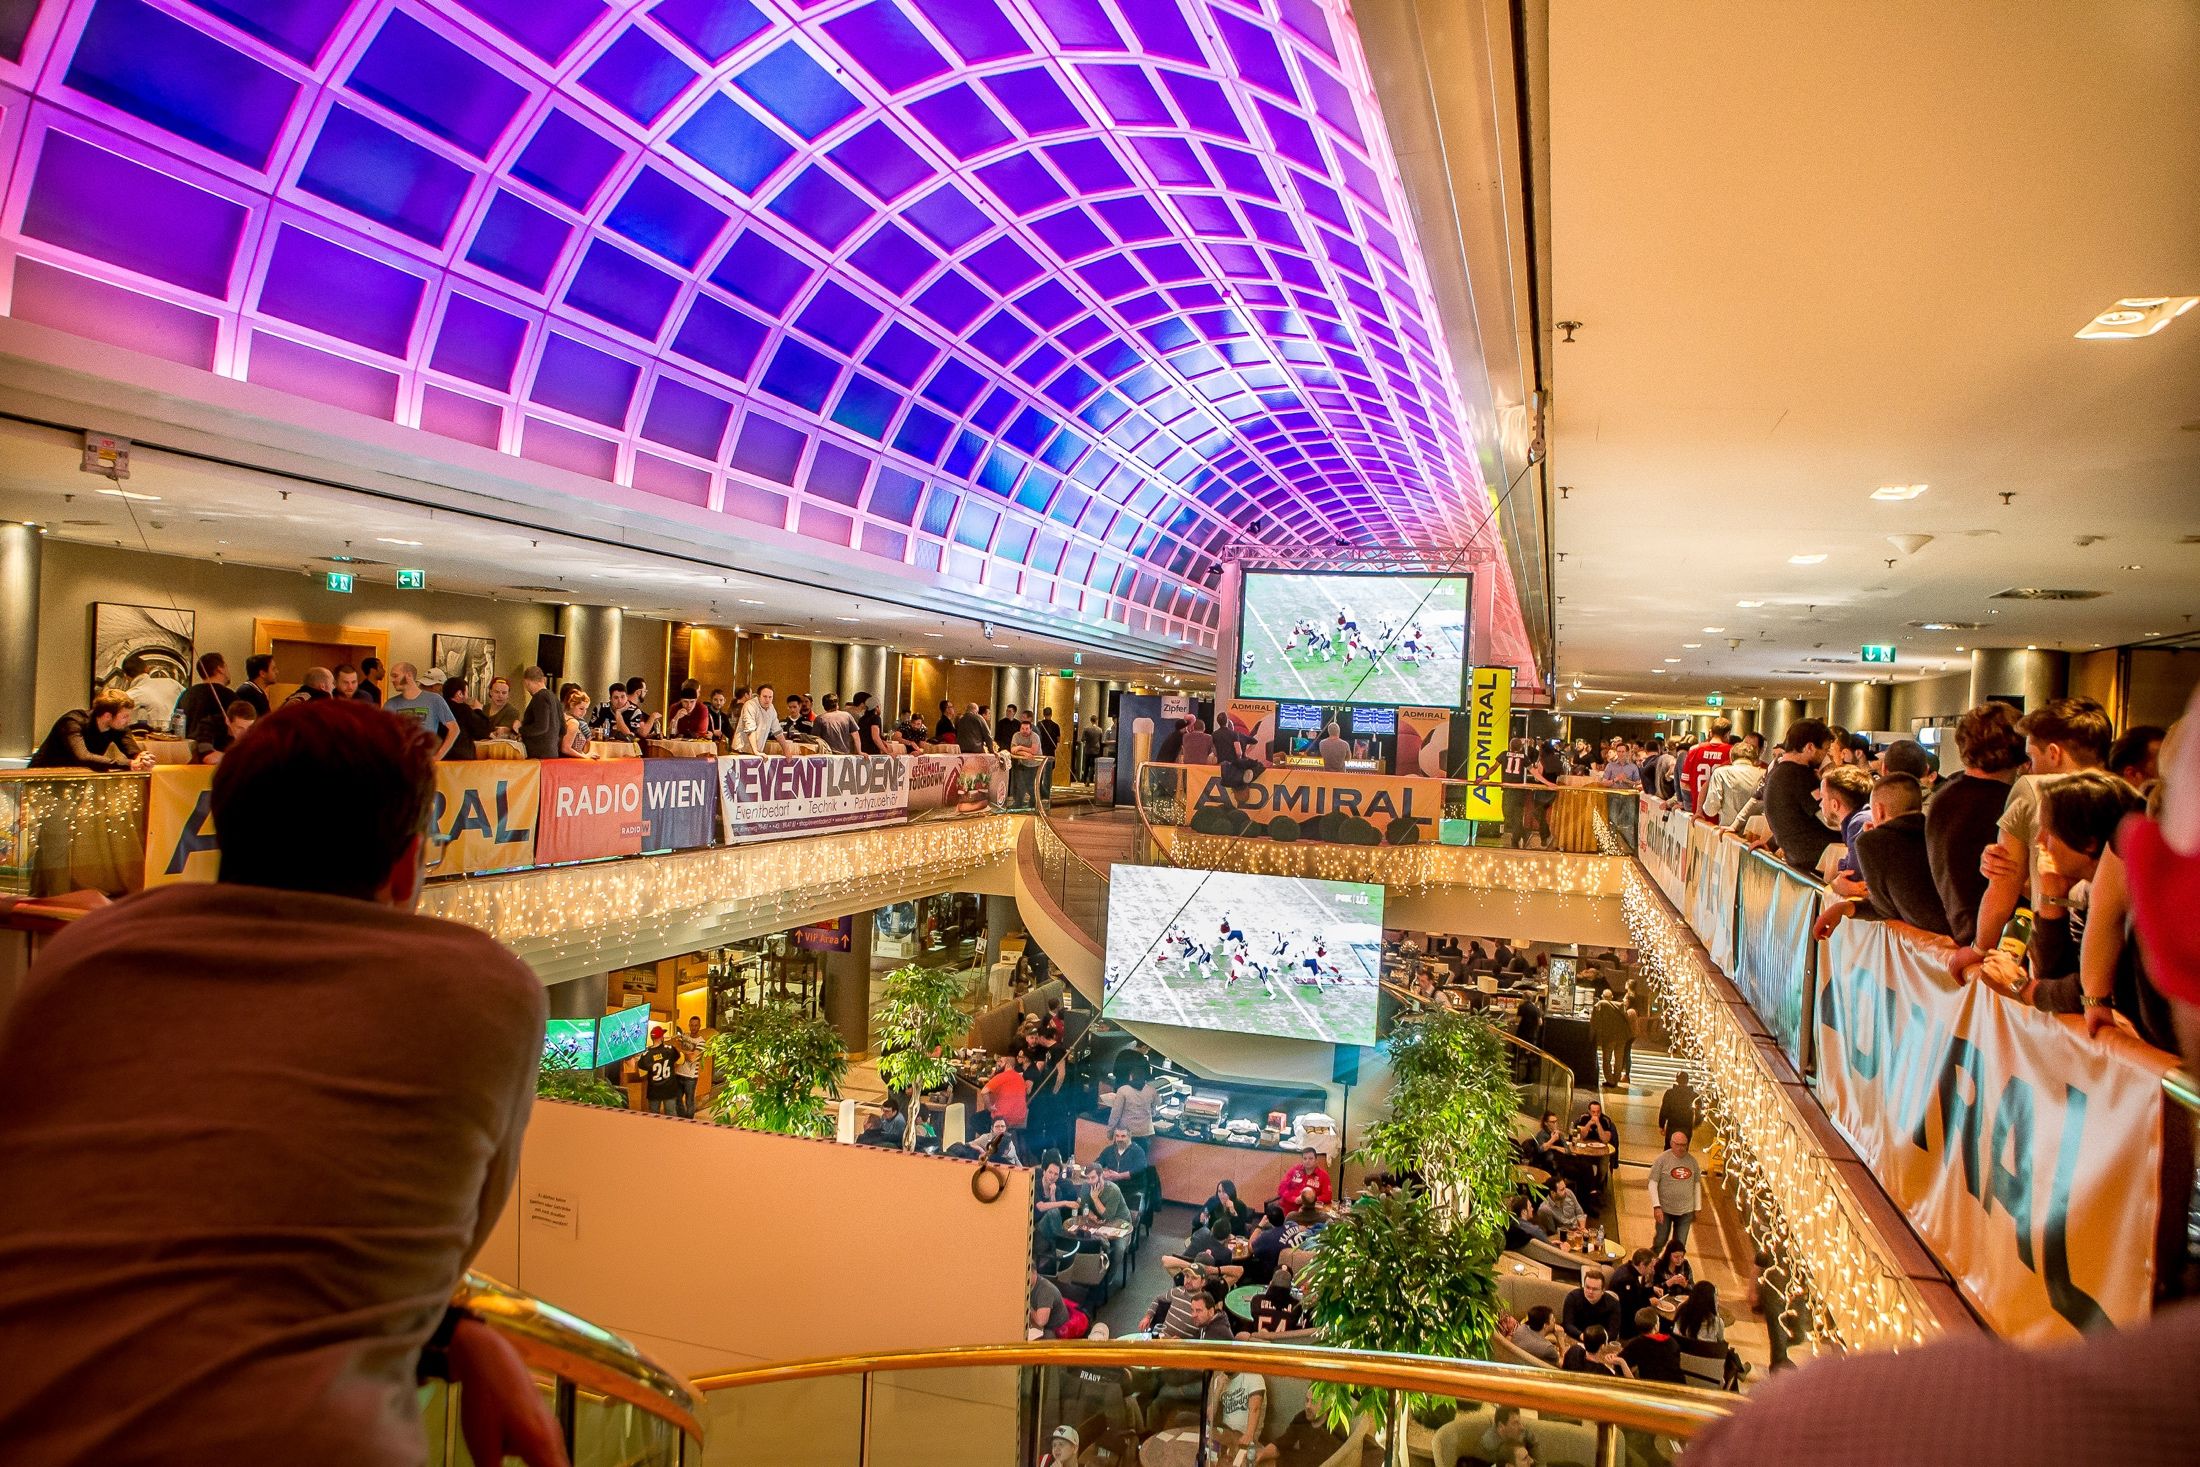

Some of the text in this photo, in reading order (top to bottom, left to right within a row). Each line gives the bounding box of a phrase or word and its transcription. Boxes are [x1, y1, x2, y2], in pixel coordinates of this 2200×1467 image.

[1163, 703, 1188, 714] Zipfer
[1231, 702, 1273, 712] ADMIRAL
[1402, 710, 1446, 720] ADMIRAL
[1473, 673, 1497, 804] ADMIRAL
[1703, 751, 1723, 760] HYDE
[1505, 757, 1520, 774] 11
[737, 757, 899, 803] EVENTLADEN
[556, 779, 706, 818] RADIO WIEN
[735, 793, 898, 820] Eventbedarf Technik Partyzubehör
[1193, 776, 1433, 826] ADMIRAL
[621, 825, 641, 835] RADIO
[652, 1059, 671, 1081] 26
[1080, 1370, 1101, 1381] BRADY
